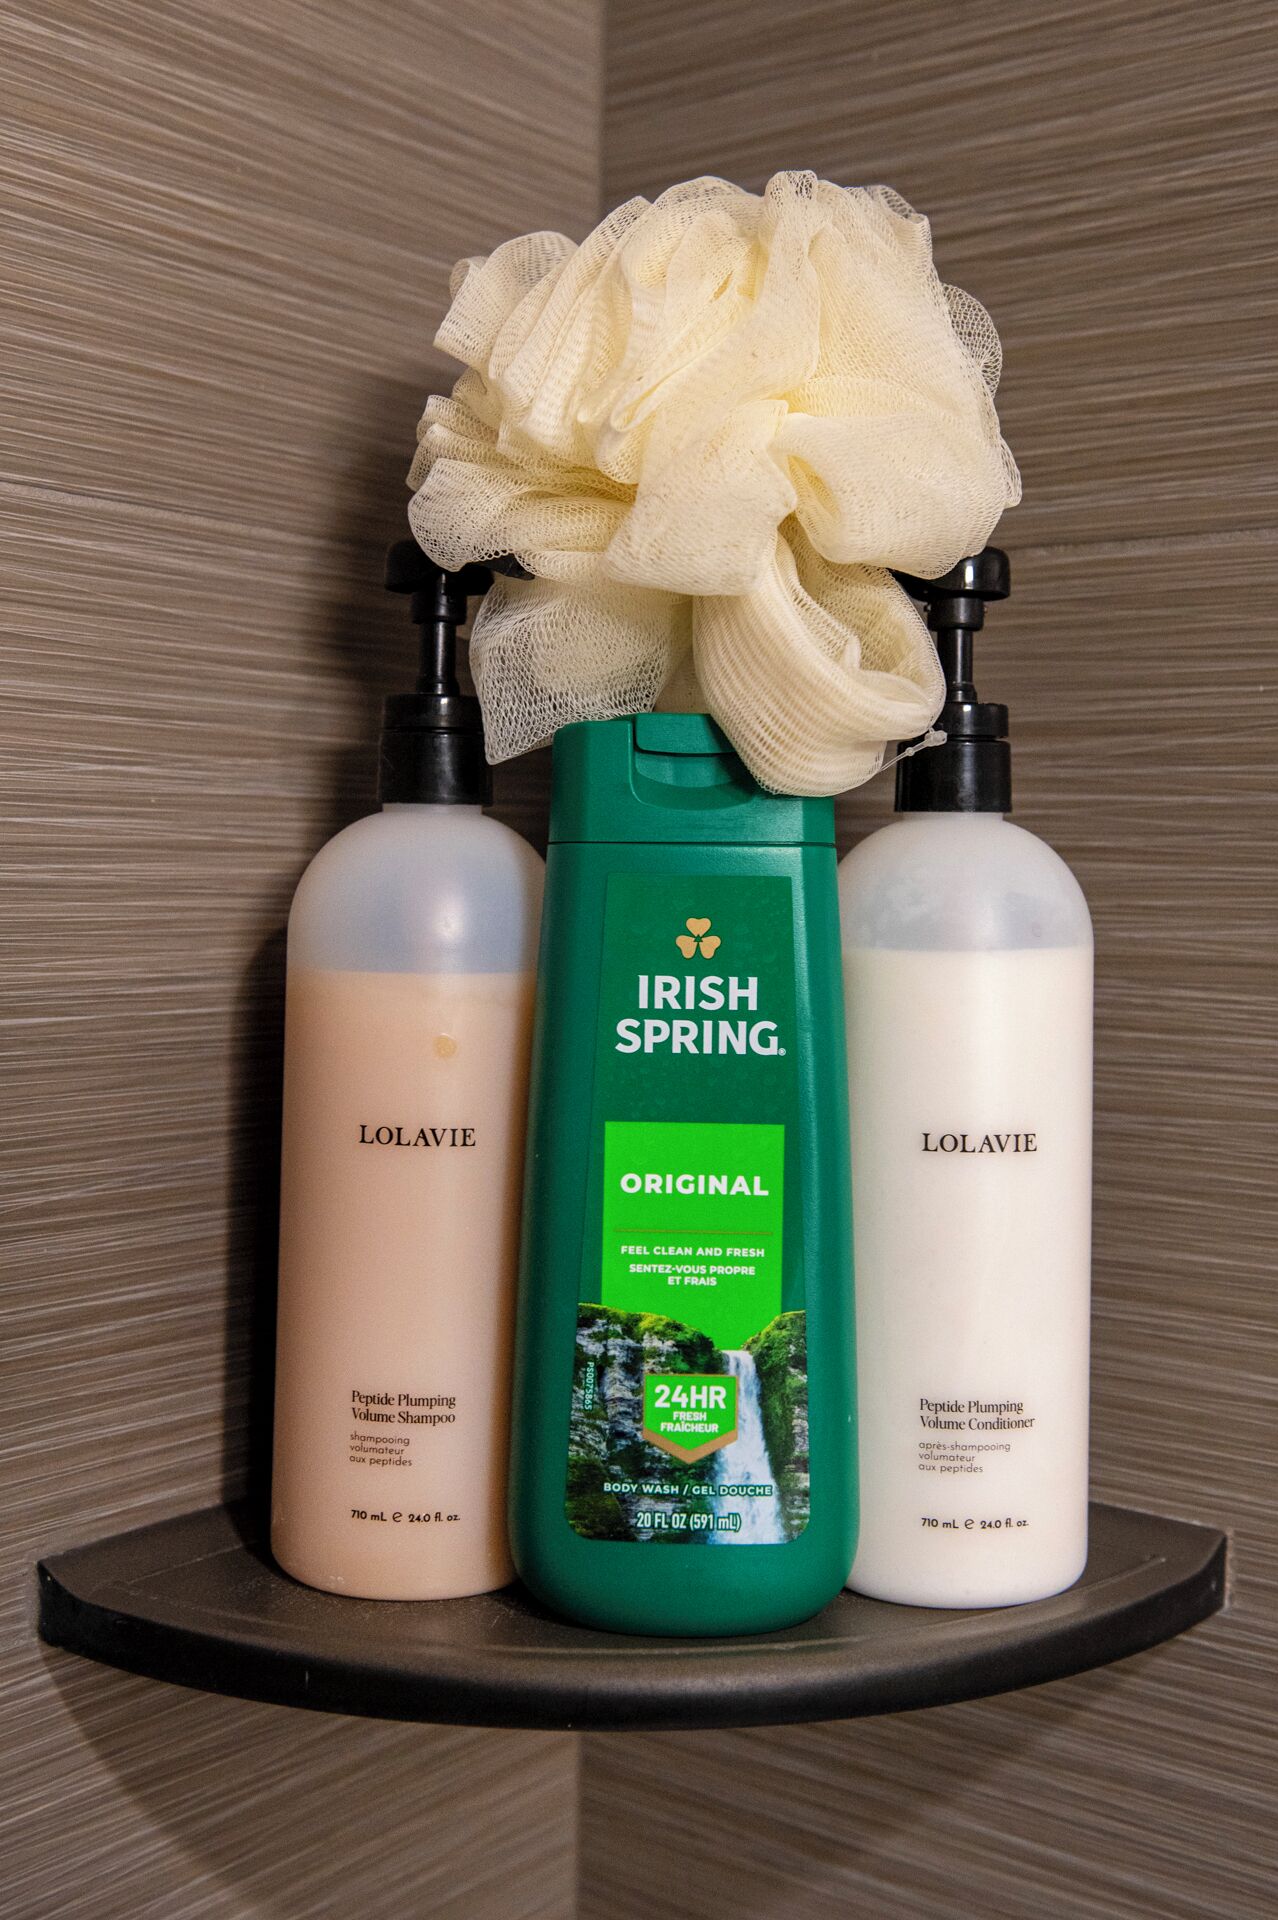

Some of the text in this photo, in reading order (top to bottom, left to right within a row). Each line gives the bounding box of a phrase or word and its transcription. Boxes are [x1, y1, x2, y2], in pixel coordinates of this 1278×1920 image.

[638, 975, 758, 1010] IRISH
[359, 1124, 476, 1147] LOLAVIE
[923, 1131, 1038, 1153] LOLAVIE
[620, 1173, 769, 1196] ORIGINAL
[620, 1246, 765, 1257] FEEL CLEAN AND FRESH
[629, 1264, 755, 1275] SENTEZ-VOUS PROPRE
[668, 1276, 717, 1286] ET FRAIS
[584, 1361, 595, 1410] PS0075865
[352, 1390, 456, 1409] Peptide Plumping
[654, 1385, 727, 1409] 24HR
[920, 1398, 1023, 1415] Peptide Plumping
[352, 1407, 456, 1426] Volume Shampoo
[673, 1411, 707, 1421] FRESH
[920, 1416, 1035, 1430] Volume Conditioner
[350, 1431, 410, 1446] shampooing
[350, 1443, 404, 1455] volumateur
[919, 1441, 1011, 1452] après-shampooing
[349, 1455, 412, 1467] aux peptides
[919, 1451, 976, 1462] volumateur
[918, 1463, 984, 1474] aux peptides
[603, 1483, 639, 1493] BODY
[642, 1484, 680, 1495] WASH
[692, 1486, 716, 1495] GEL
[719, 1486, 773, 1496] DOUCHE
[351, 1510, 367, 1520] 710
[371, 1512, 387, 1522] mL
[408, 1514, 431, 1522] 24.0
[434, 1512, 443, 1522] fl.
[447, 1514, 460, 1522] oz.
[636, 1512, 742, 1533] 20 FL OZ (591 mL)
[921, 1518, 939, 1528] 710
[942, 1519, 959, 1529] mL
[980, 1520, 1002, 1529] 24.0
[1005, 1518, 1014, 1528] fl.
[1016, 1519, 1029, 1527] oz.
